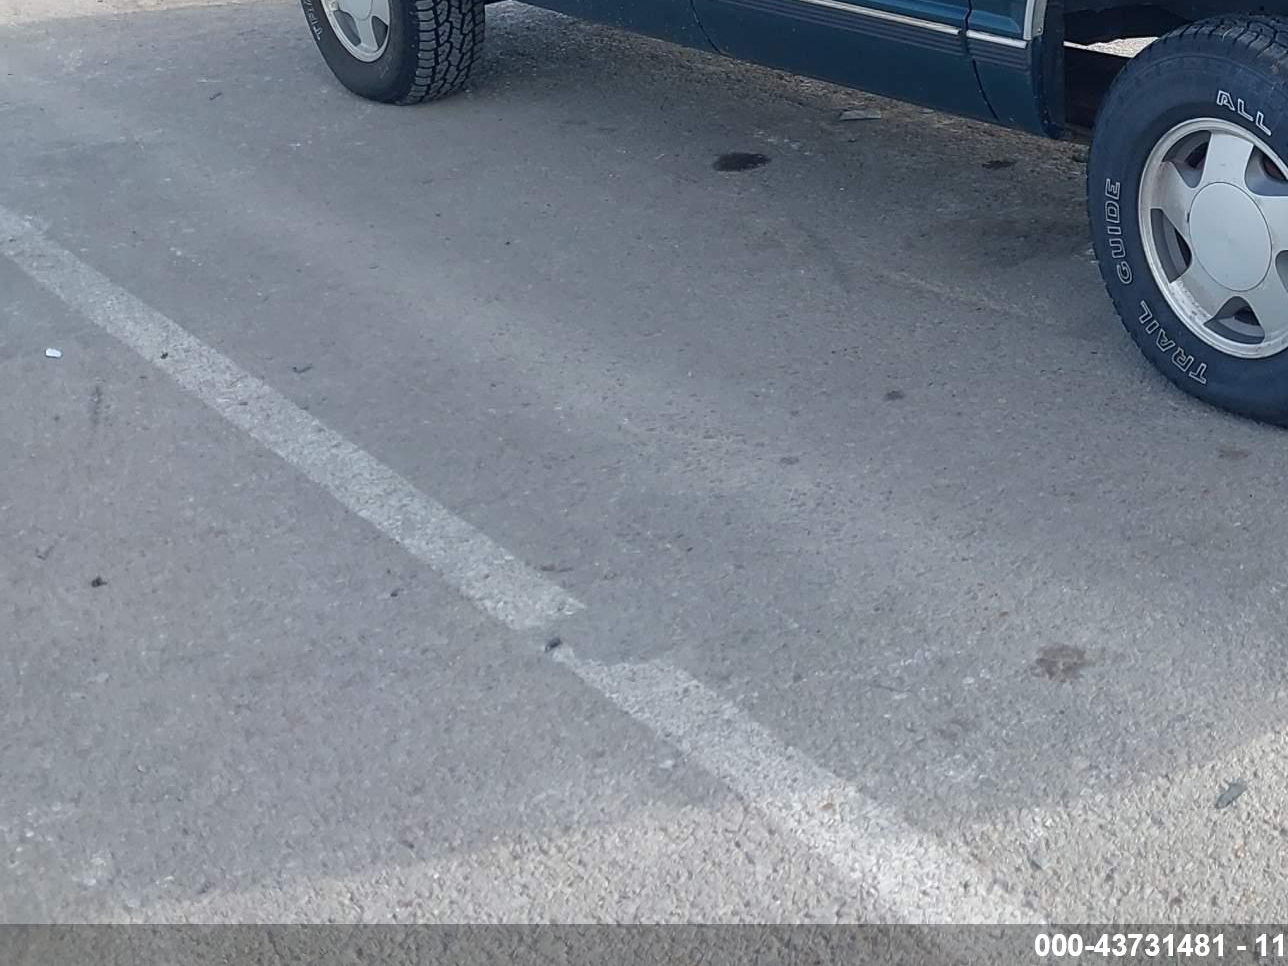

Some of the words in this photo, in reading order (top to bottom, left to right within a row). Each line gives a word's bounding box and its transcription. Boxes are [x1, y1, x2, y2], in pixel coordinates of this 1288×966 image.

[1216, 89, 1272, 136] ALL
[1105, 178, 1133, 285] GUIDE
[1138, 300, 1208, 385] TRAIL
